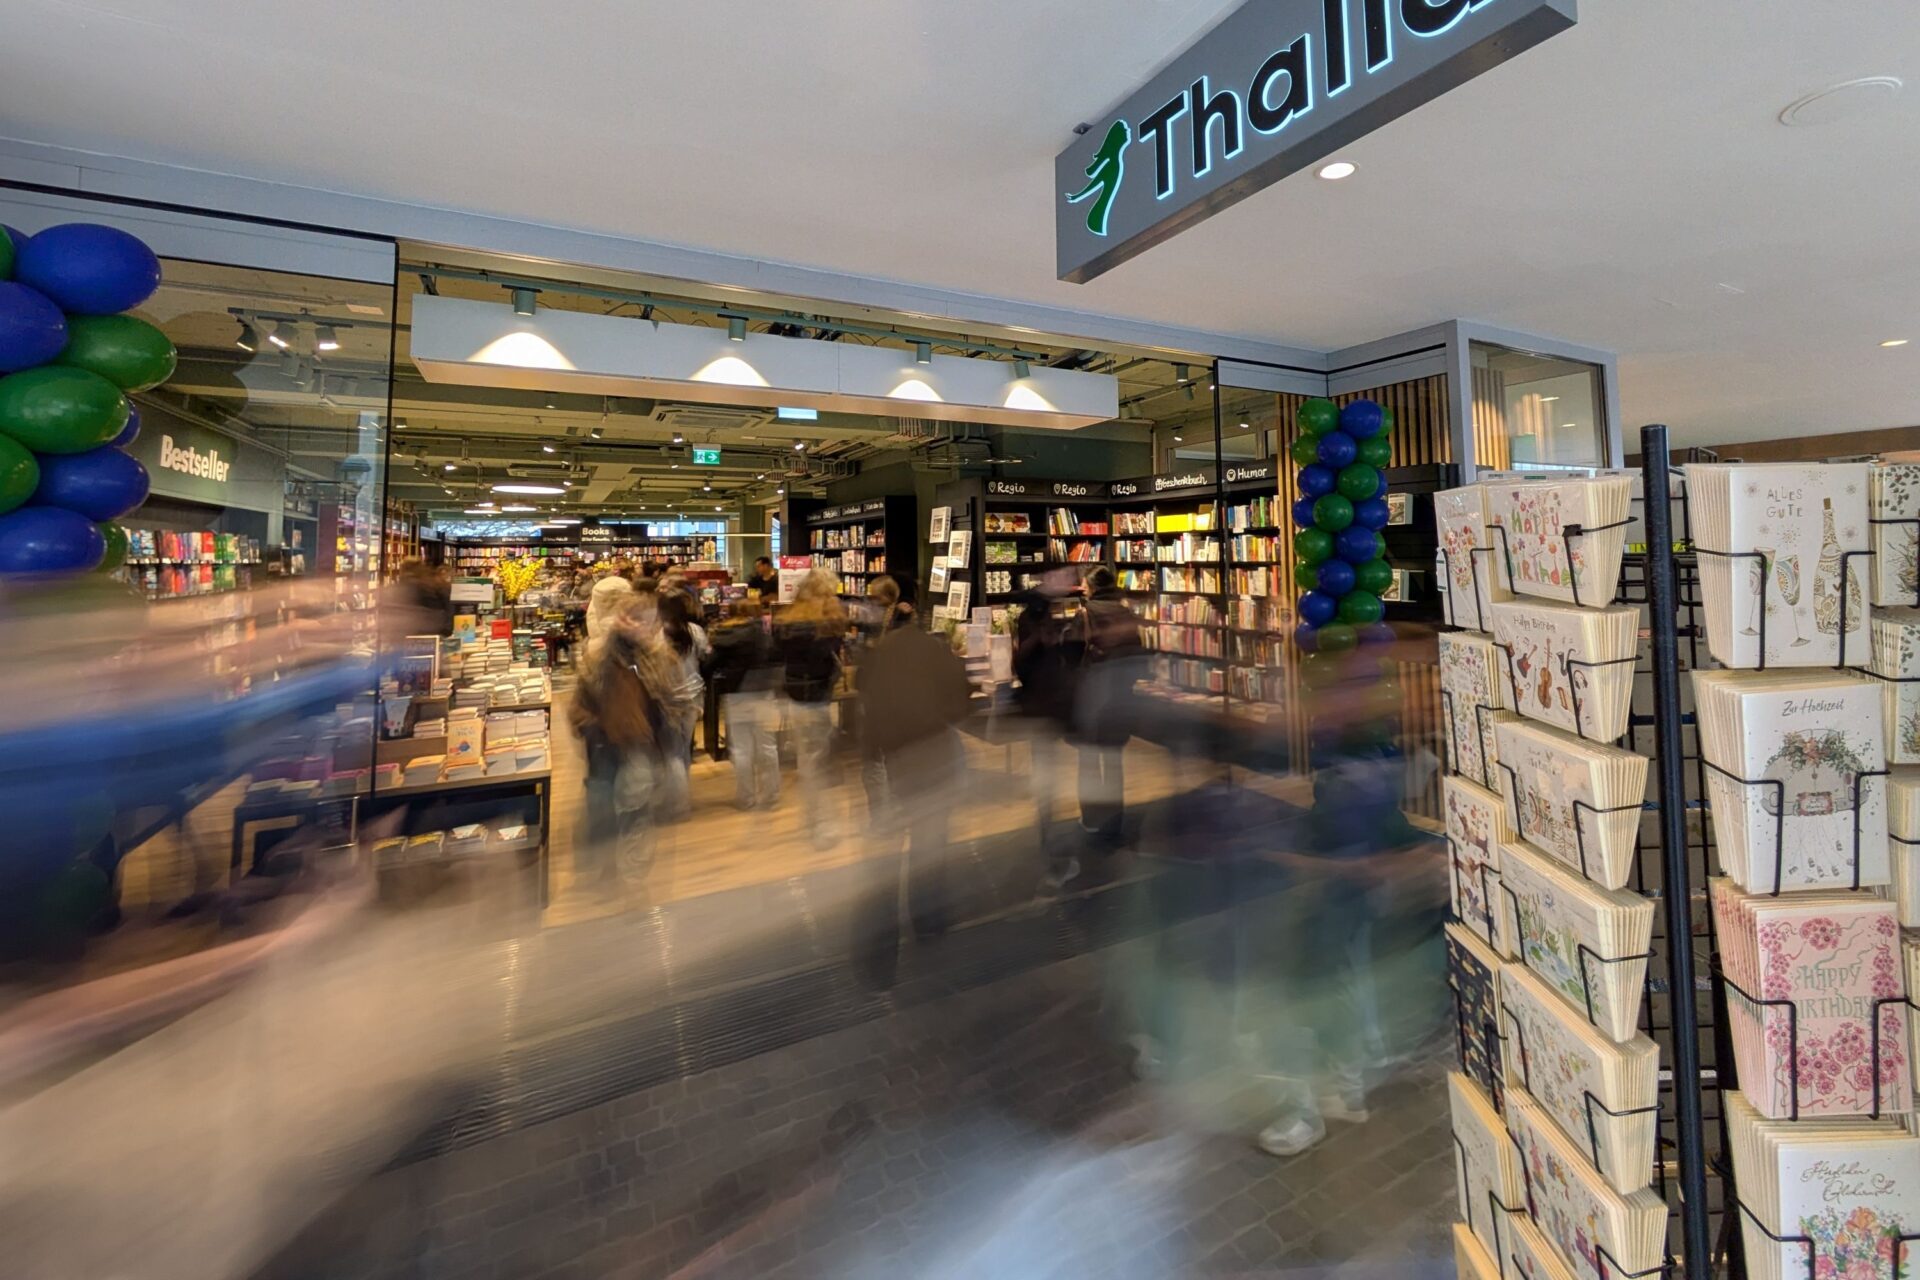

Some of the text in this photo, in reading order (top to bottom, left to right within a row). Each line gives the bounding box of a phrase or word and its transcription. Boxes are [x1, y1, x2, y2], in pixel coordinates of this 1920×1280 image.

[160, 434, 230, 482] Bestseller
[1162, 473, 1208, 488] Geschenkbuch
[1237, 467, 1268, 480] Humor
[997, 481, 1025, 495] Regio
[1061, 483, 1087, 496] Regio
[1116, 483, 1137, 496] Regio
[1767, 486, 1803, 502] ALLES
[1766, 503, 1804, 519] GUTE
[582, 527, 610, 536] Books
[1781, 698, 1845, 717] Zur Hochzeit
[1802, 965, 1862, 989] HAPPY
[1795, 996, 1875, 1019] IRTHDAY
